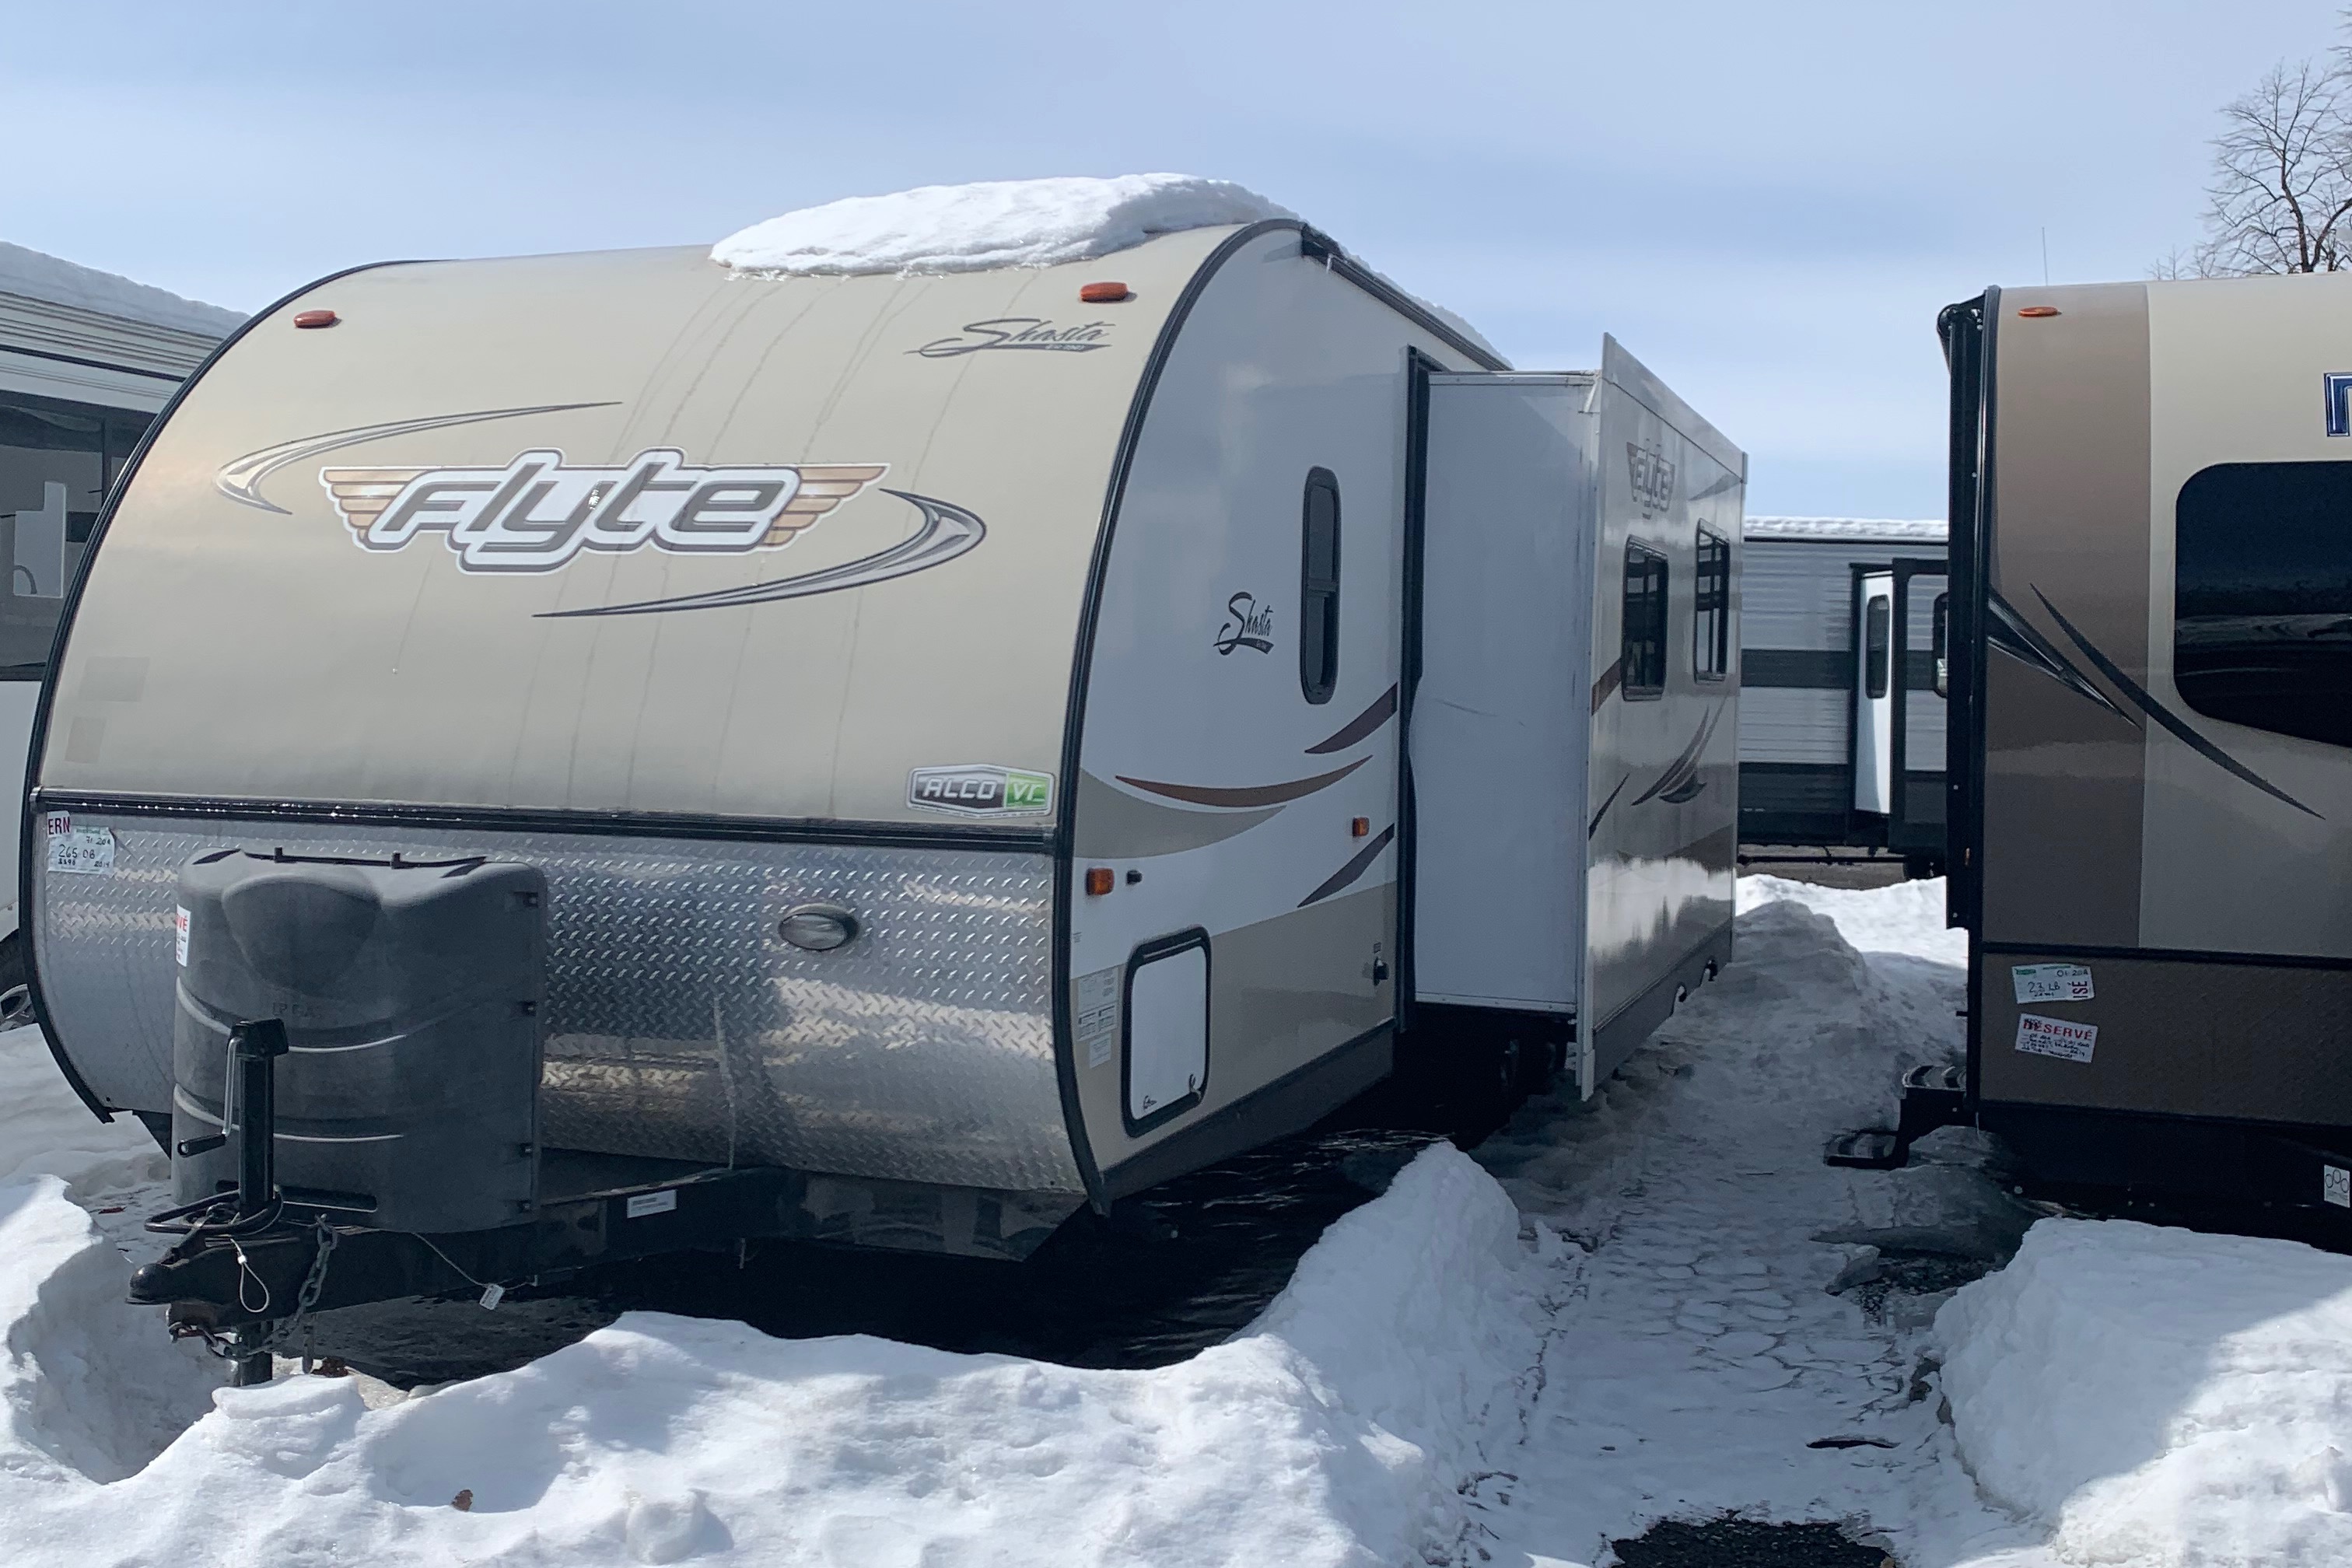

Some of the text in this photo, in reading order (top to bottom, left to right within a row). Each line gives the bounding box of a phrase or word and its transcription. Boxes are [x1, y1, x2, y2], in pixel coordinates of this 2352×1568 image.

[903, 317, 1115, 358] Shasta
[370, 449, 798, 572] Flyte
[1213, 591, 1275, 656] Shasta
[923, 777, 997, 800] ALCO
[58, 844, 78, 859] 265
